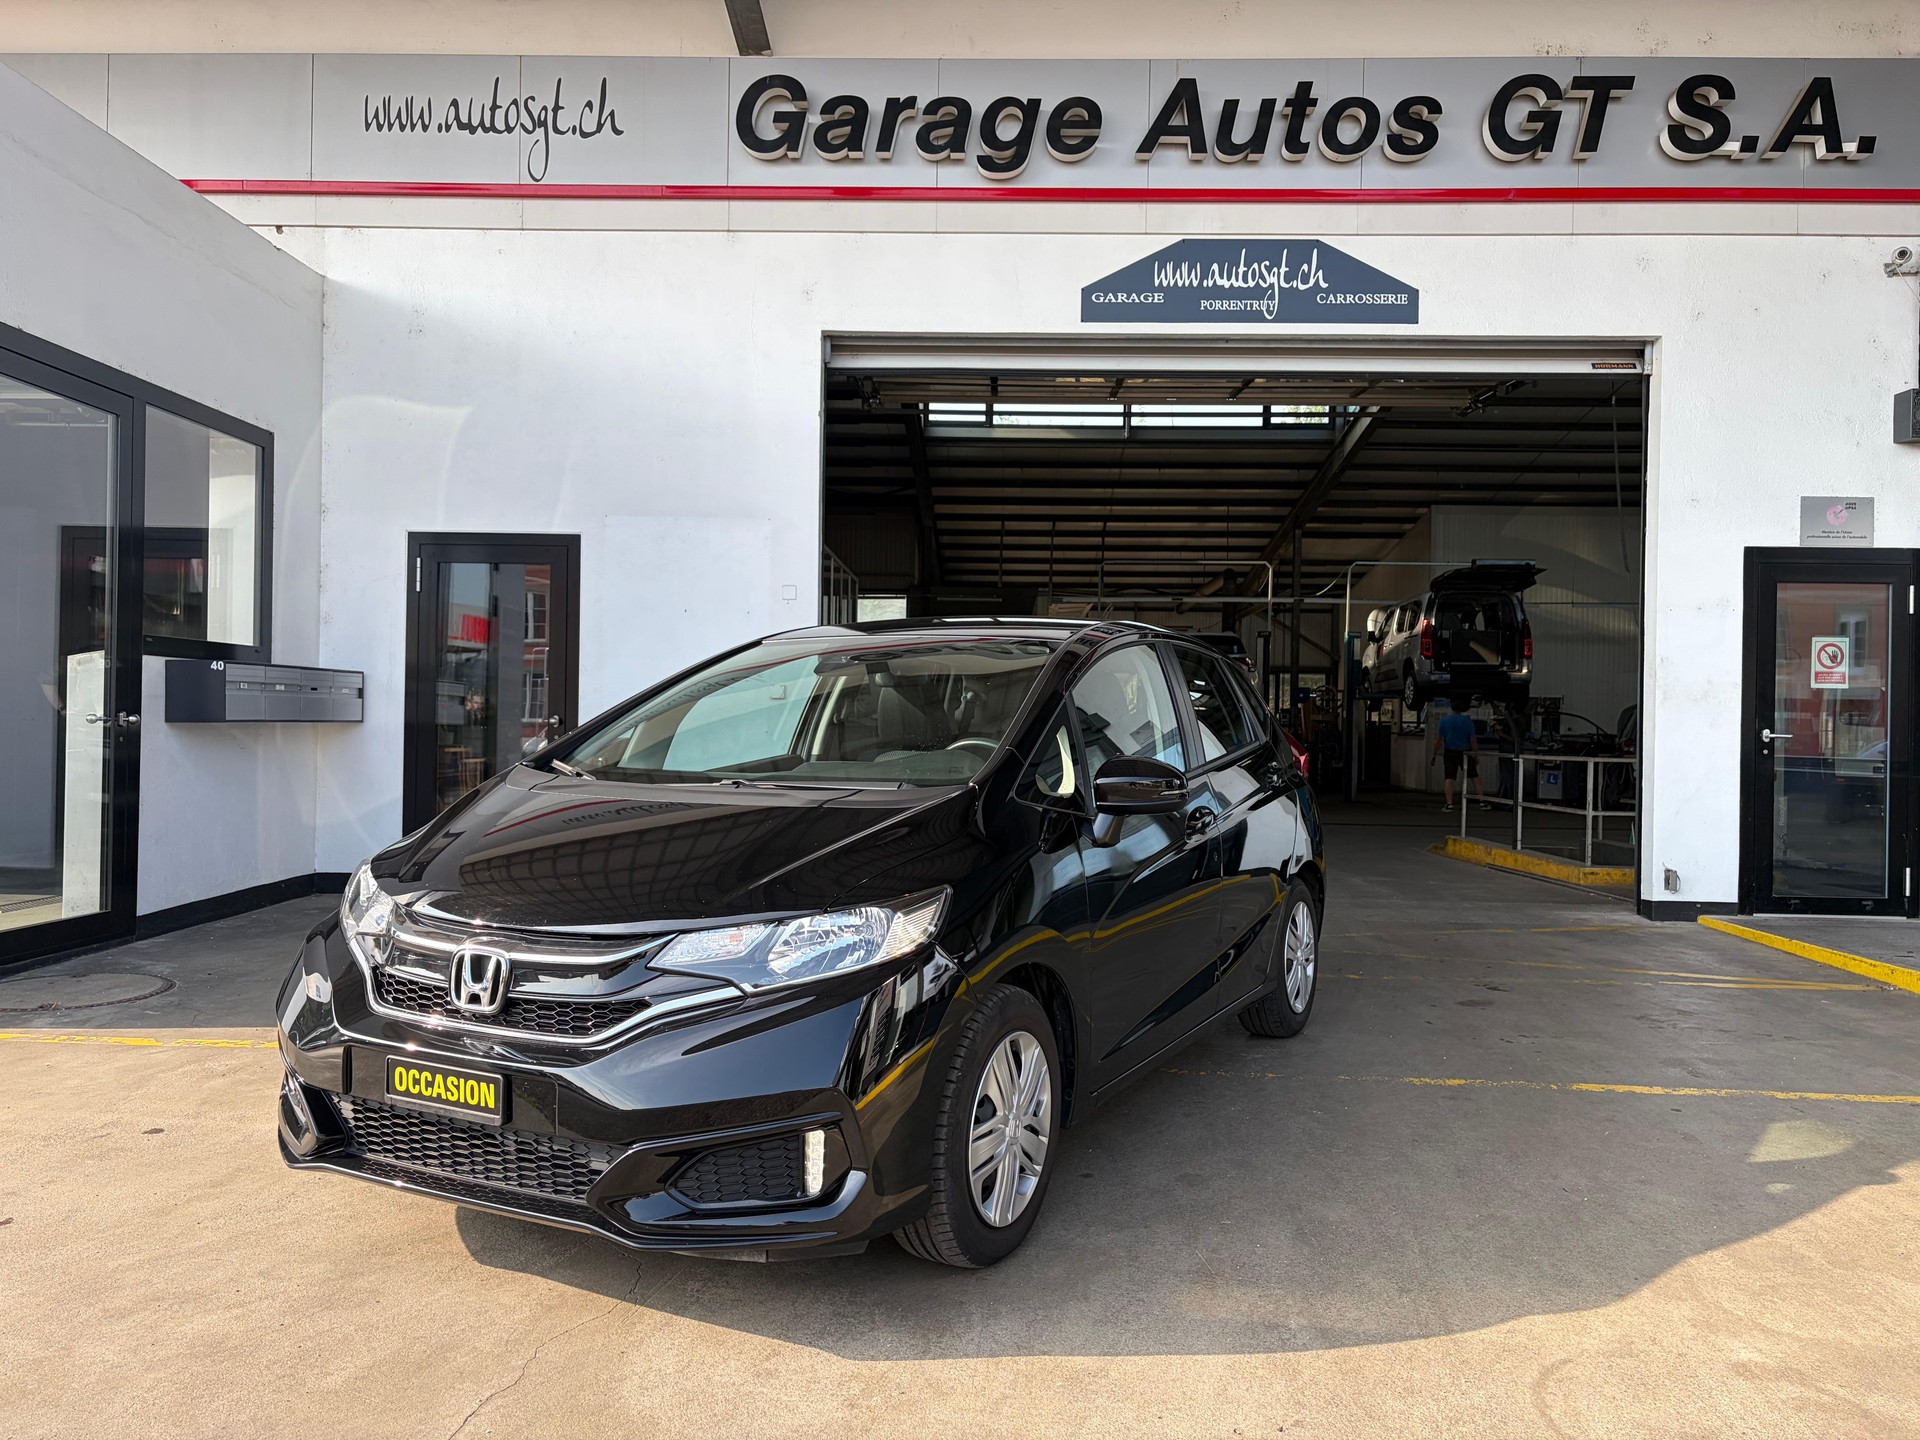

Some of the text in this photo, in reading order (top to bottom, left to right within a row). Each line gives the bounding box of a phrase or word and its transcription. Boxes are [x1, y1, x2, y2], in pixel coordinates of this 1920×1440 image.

[364, 76, 624, 182] www.autosgt.ch
[736, 73, 1878, 179] Garage Autos GT S.A.
[1091, 292, 1164, 303] GARAGE
[1154, 248, 1328, 320] www.autosgt.ch
[1200, 300, 1275, 311] PORRENTRUY
[1316, 293, 1408, 305] CARROSSERIE
[210, 660, 224, 671] 40
[394, 1066, 495, 1109] OCCASION
